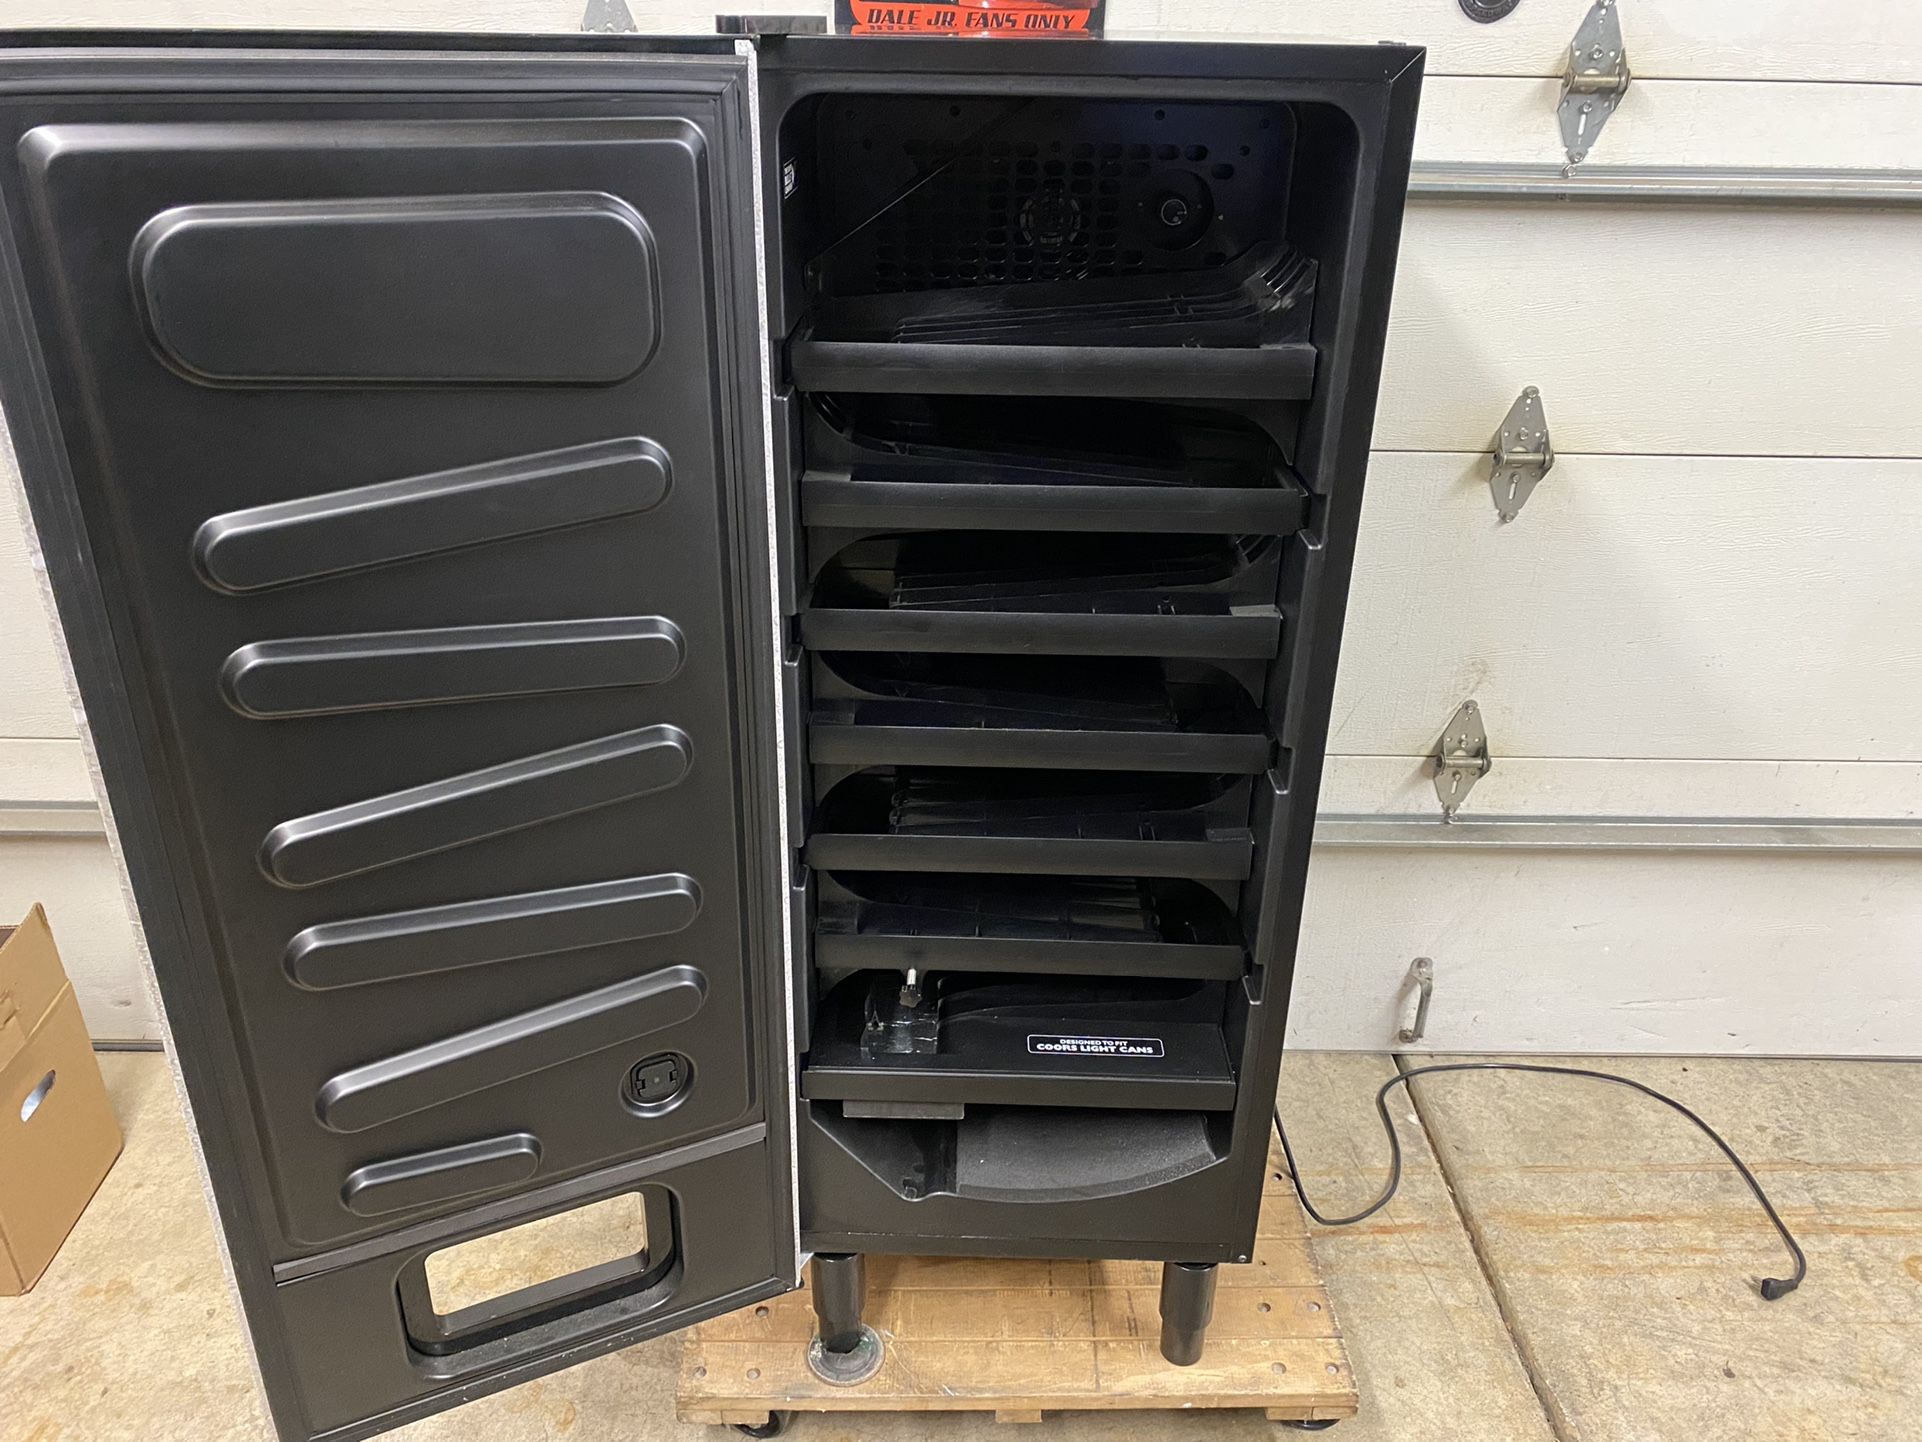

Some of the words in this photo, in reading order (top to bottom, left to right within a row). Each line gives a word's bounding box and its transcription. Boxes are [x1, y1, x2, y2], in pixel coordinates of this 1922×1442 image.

[867, 8, 921, 25] DALE
[927, 10, 958, 27] JR.
[965, 11, 1018, 29] FANS
[1024, 13, 1076, 29] ONLY
[1037, 1043, 1077, 1051] COORS
[1080, 1044, 1117, 1052] LIGHT
[1120, 1046, 1154, 1054] CANS
